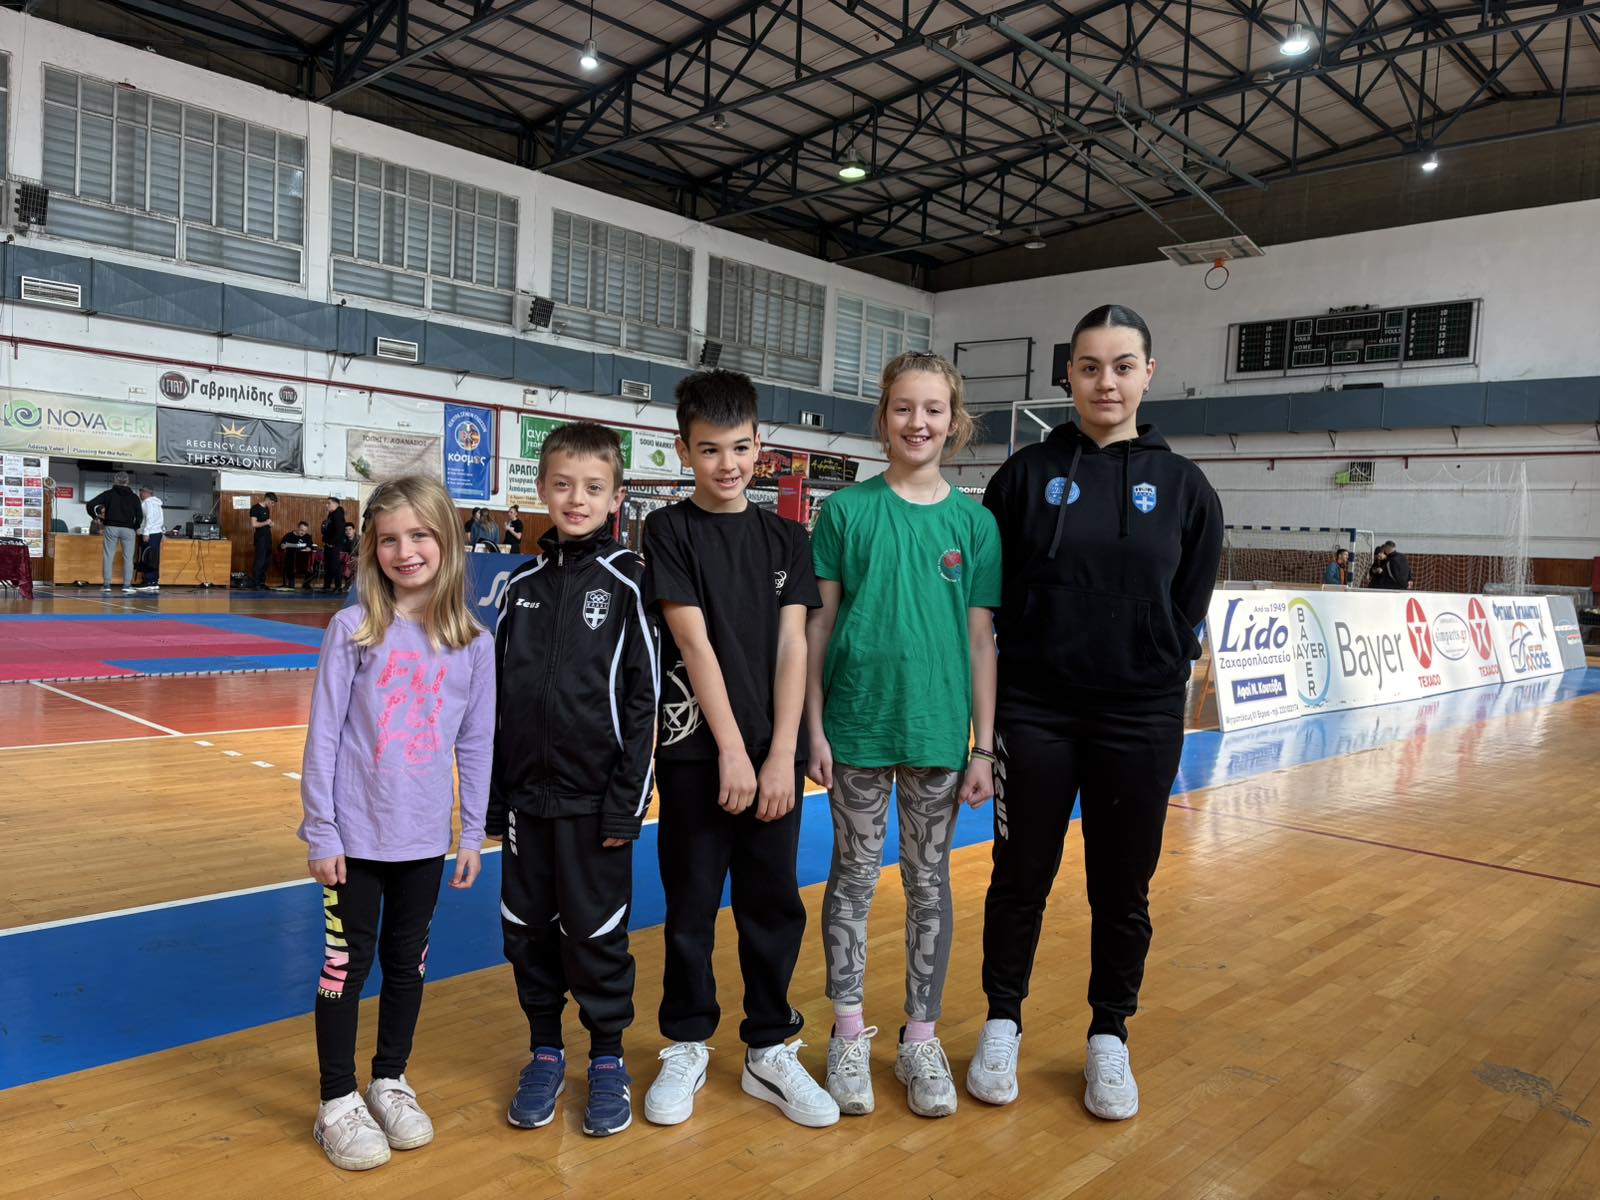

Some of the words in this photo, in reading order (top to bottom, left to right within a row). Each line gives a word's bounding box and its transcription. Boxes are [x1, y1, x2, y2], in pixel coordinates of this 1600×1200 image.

[166, 379, 184, 394] FIAT
[190, 378, 274, 407] Γαβριηλίδης
[186, 439, 235, 450] REGENCY
[239, 444, 277, 454] CASINO
[186, 452, 277, 470] THESSALONIKI
[509, 463, 539, 477] ΑΡΑΠΟ
[1218, 597, 1290, 653] Lido
[1219, 651, 1292, 670] Ζαχαροπλαστείο
[1335, 621, 1404, 691] Bayer
[1418, 673, 1442, 688] TEXACO
[508, 807, 518, 856] eus
